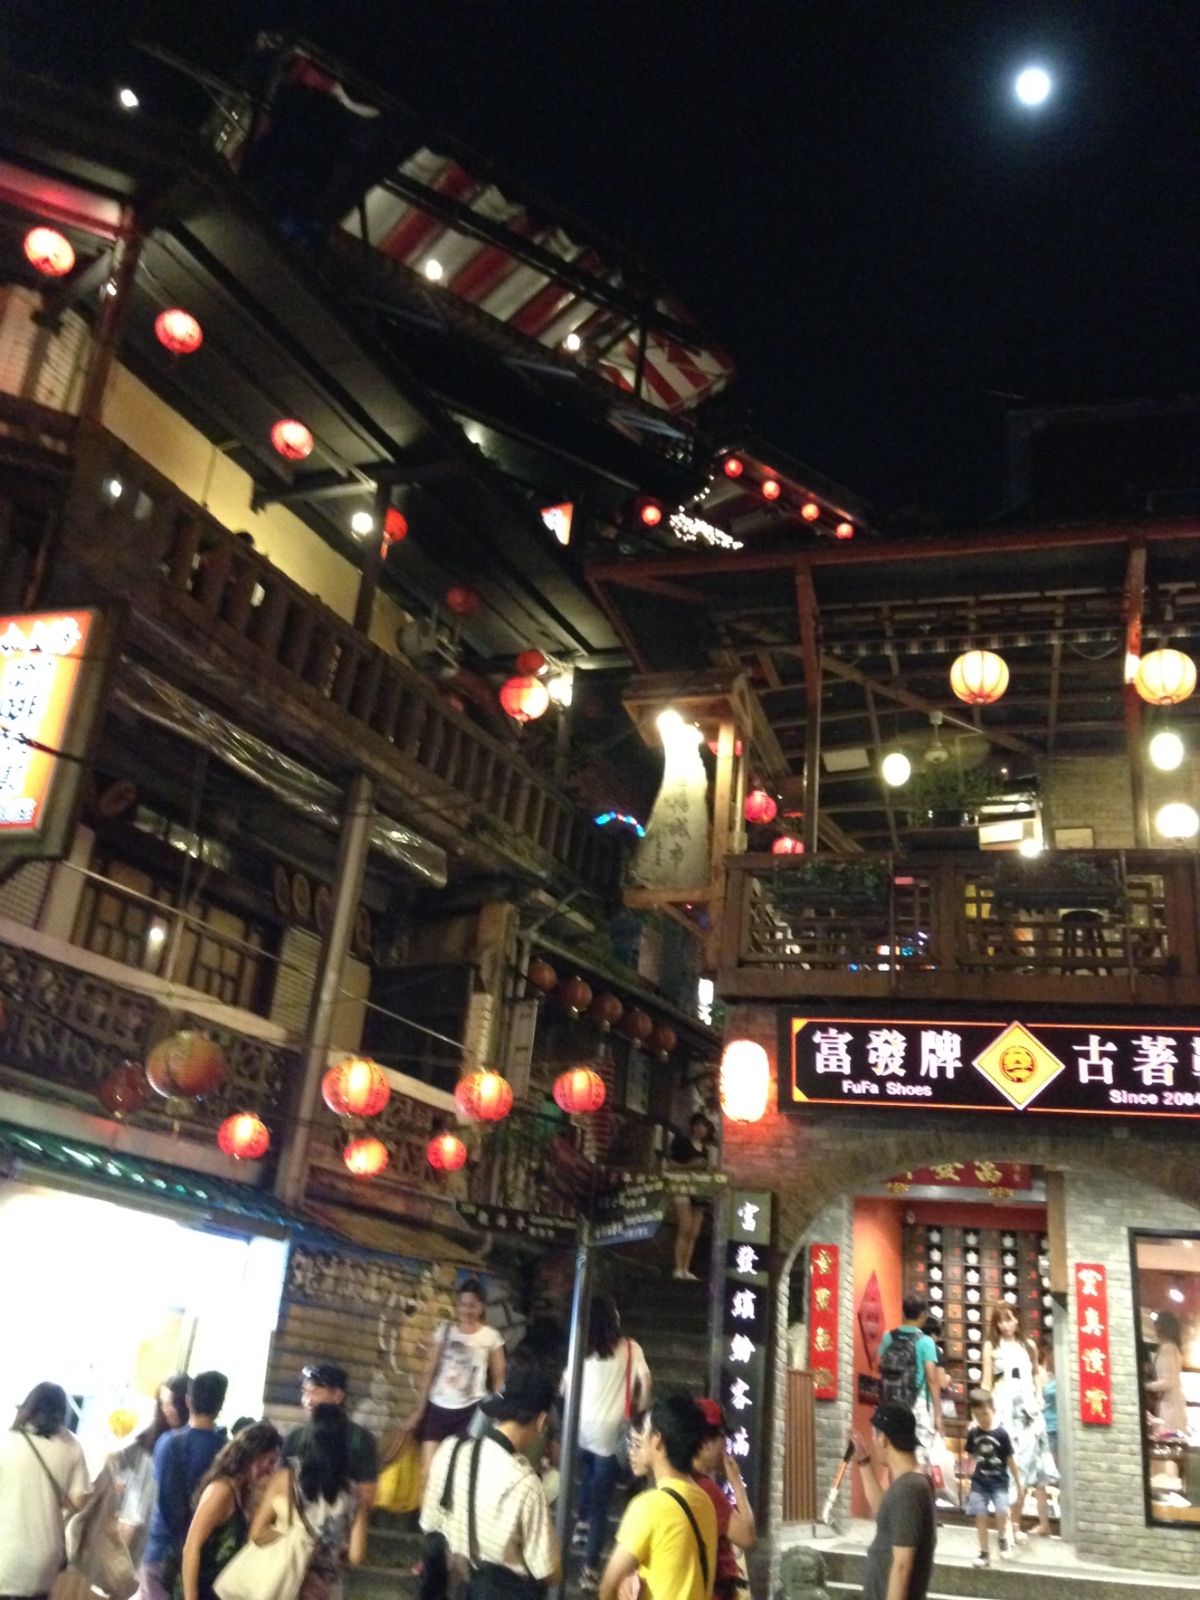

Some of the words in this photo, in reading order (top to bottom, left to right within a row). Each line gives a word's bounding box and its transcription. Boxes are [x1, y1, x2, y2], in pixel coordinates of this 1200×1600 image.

[812, 1027, 963, 1079] 富發牌
[1072, 1034, 1200, 1087] 古著
[841, 1080, 880, 1095] FuFa
[885, 1081, 933, 1097] Shoes
[1109, 1089, 1159, 1105] Since
